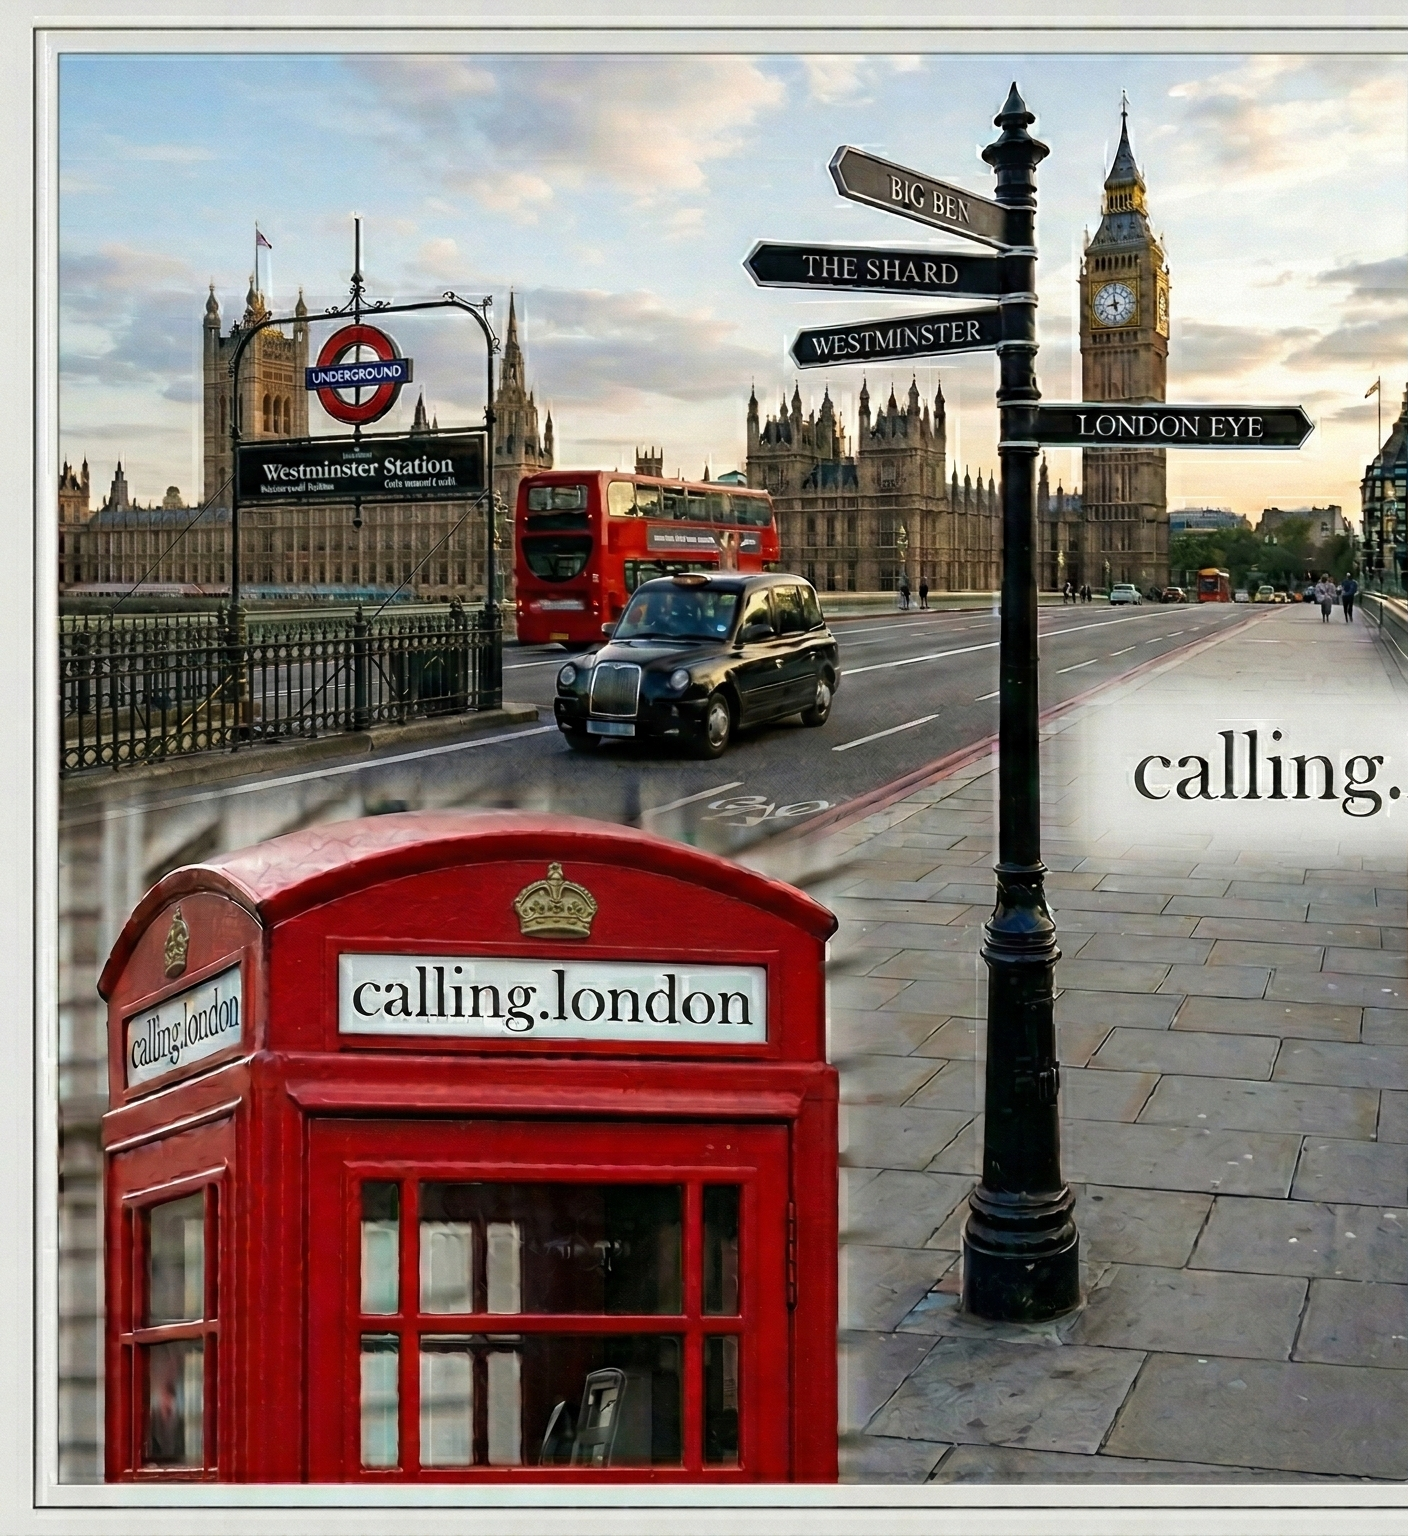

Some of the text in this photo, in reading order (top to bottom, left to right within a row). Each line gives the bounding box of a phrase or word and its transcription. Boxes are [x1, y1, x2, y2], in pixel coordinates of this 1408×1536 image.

[891, 175, 970, 224] BIG BEN
[802, 254, 959, 285] THE SHARD
[812, 319, 981, 356] WESTMINSTER
[312, 365, 402, 384] UNDERGROUND
[1077, 413, 1263, 438] LONDON EYE
[262, 455, 455, 481] Westminster Station
[352, 965, 754, 1032] calling.london
